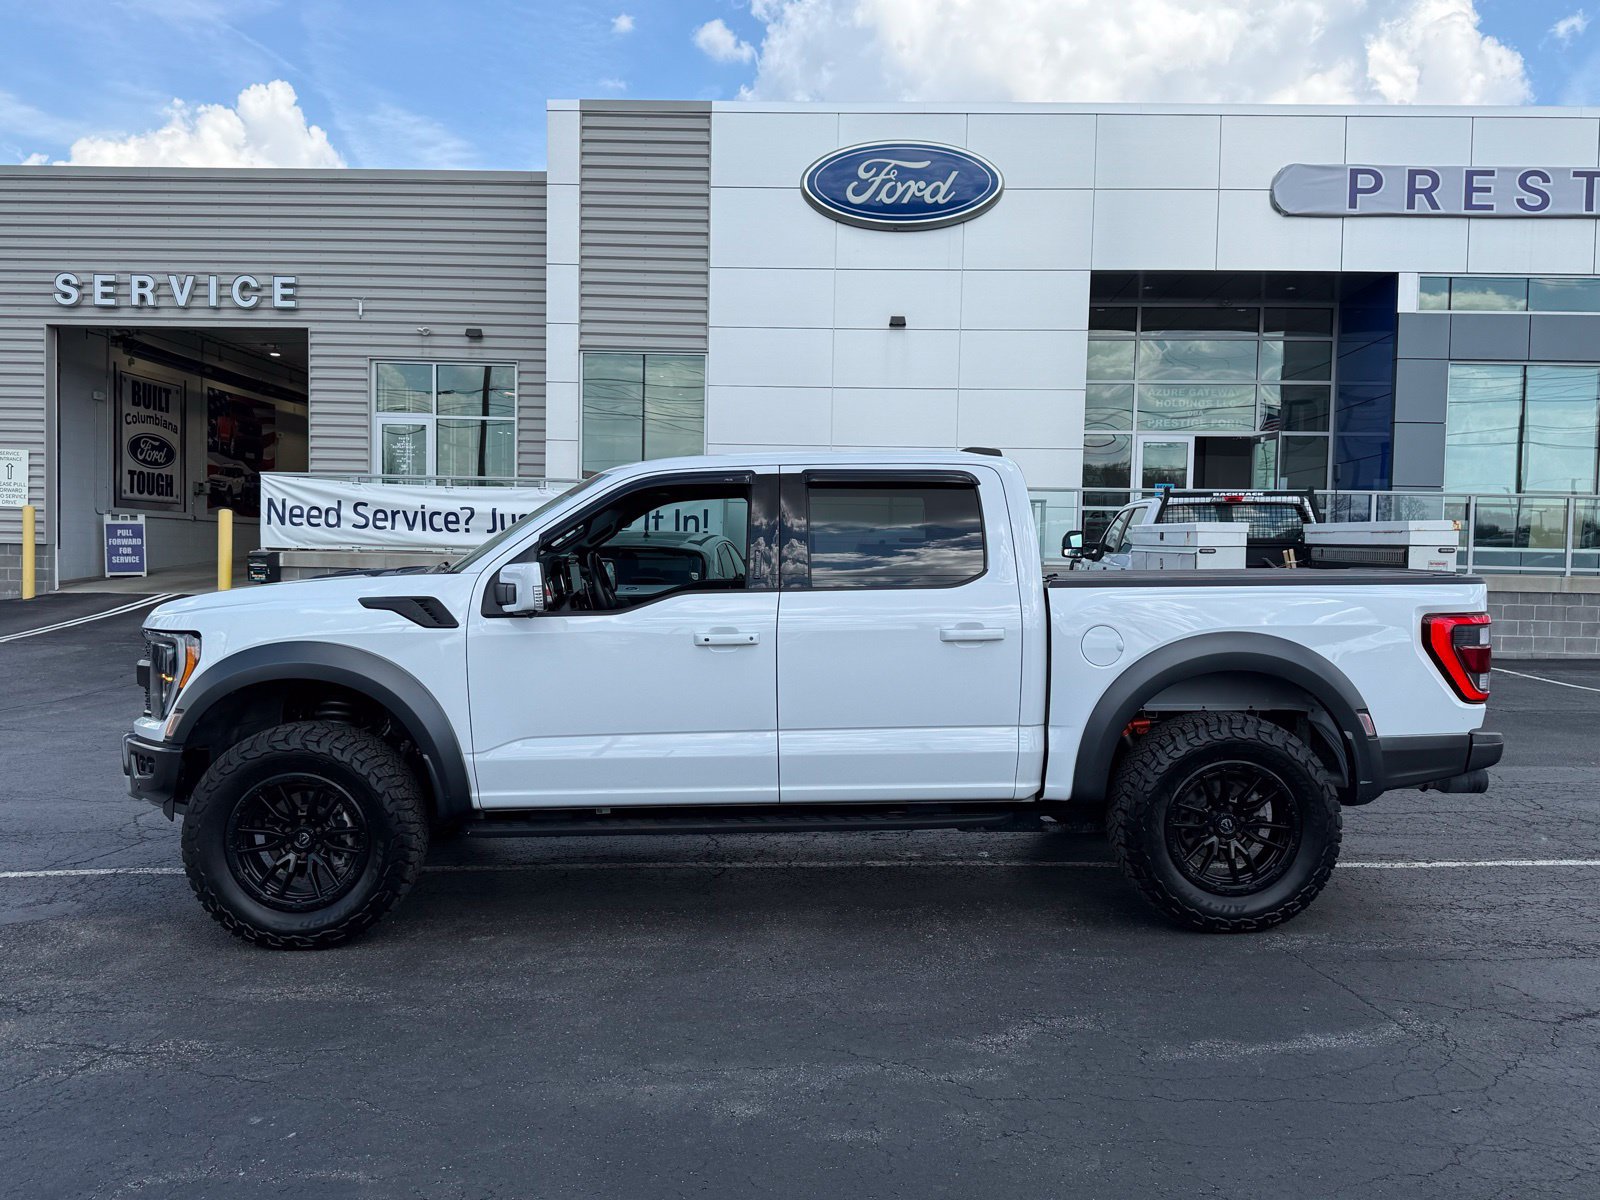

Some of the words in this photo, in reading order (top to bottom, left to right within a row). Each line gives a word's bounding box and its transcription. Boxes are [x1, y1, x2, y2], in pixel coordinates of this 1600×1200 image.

[846, 158, 959, 205] Ford
[1347, 167, 1600, 213] PREST
[53, 272, 298, 309] SERVICE
[131, 380, 172, 414] BUILT
[124, 412, 179, 435] Columbiana
[137, 438, 167, 463] Ford
[127, 469, 174, 497] TOUGH
[266, 497, 342, 528] Need
[351, 501, 476, 533] Service?
[674, 508, 709, 534] In!
[108, 538, 142, 546] FORWARD
[117, 529, 133, 537] PULL
[111, 555, 140, 563] SERVICE
